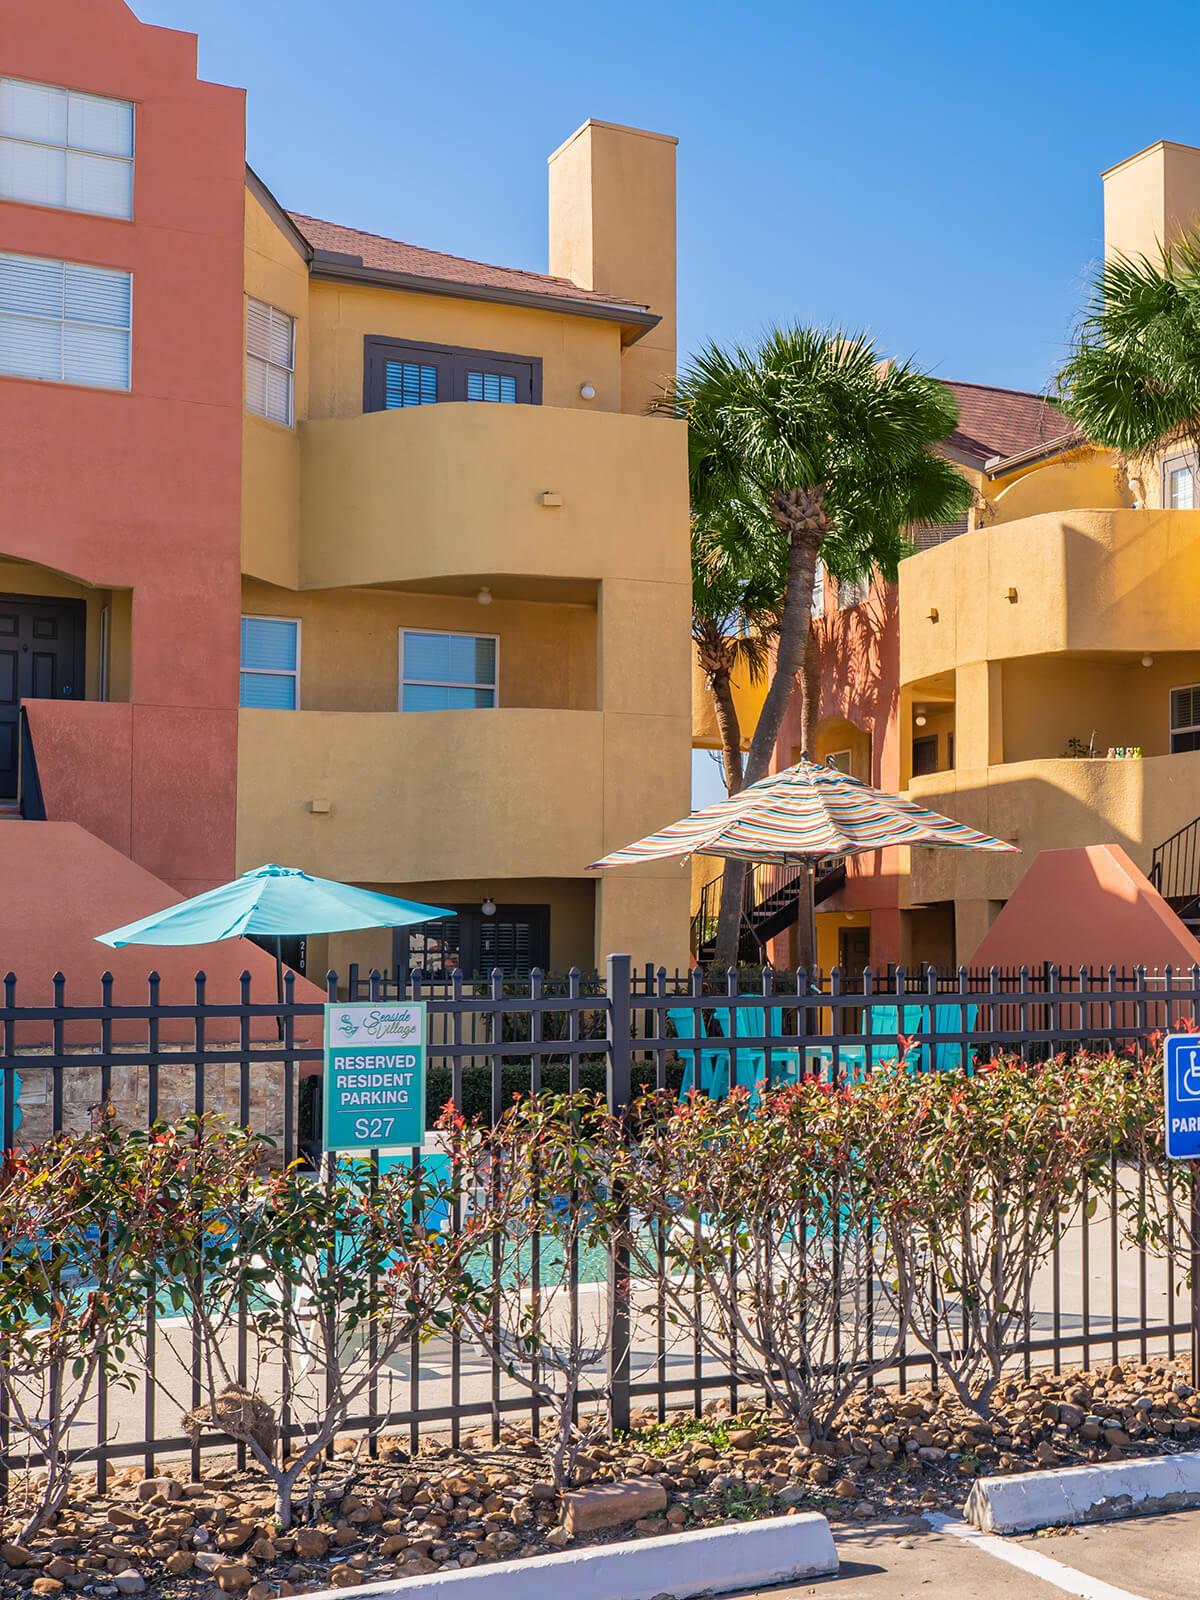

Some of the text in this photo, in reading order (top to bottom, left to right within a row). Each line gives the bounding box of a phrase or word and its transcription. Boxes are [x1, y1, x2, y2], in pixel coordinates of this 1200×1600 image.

[363, 1009, 411, 1028] Seaside
[368, 1021, 416, 1039] Village
[334, 1055, 417, 1070] RESERVED
[336, 1073, 414, 1089] RESIDENT
[341, 1090, 409, 1106] PARKING
[354, 1117, 395, 1139] S27
